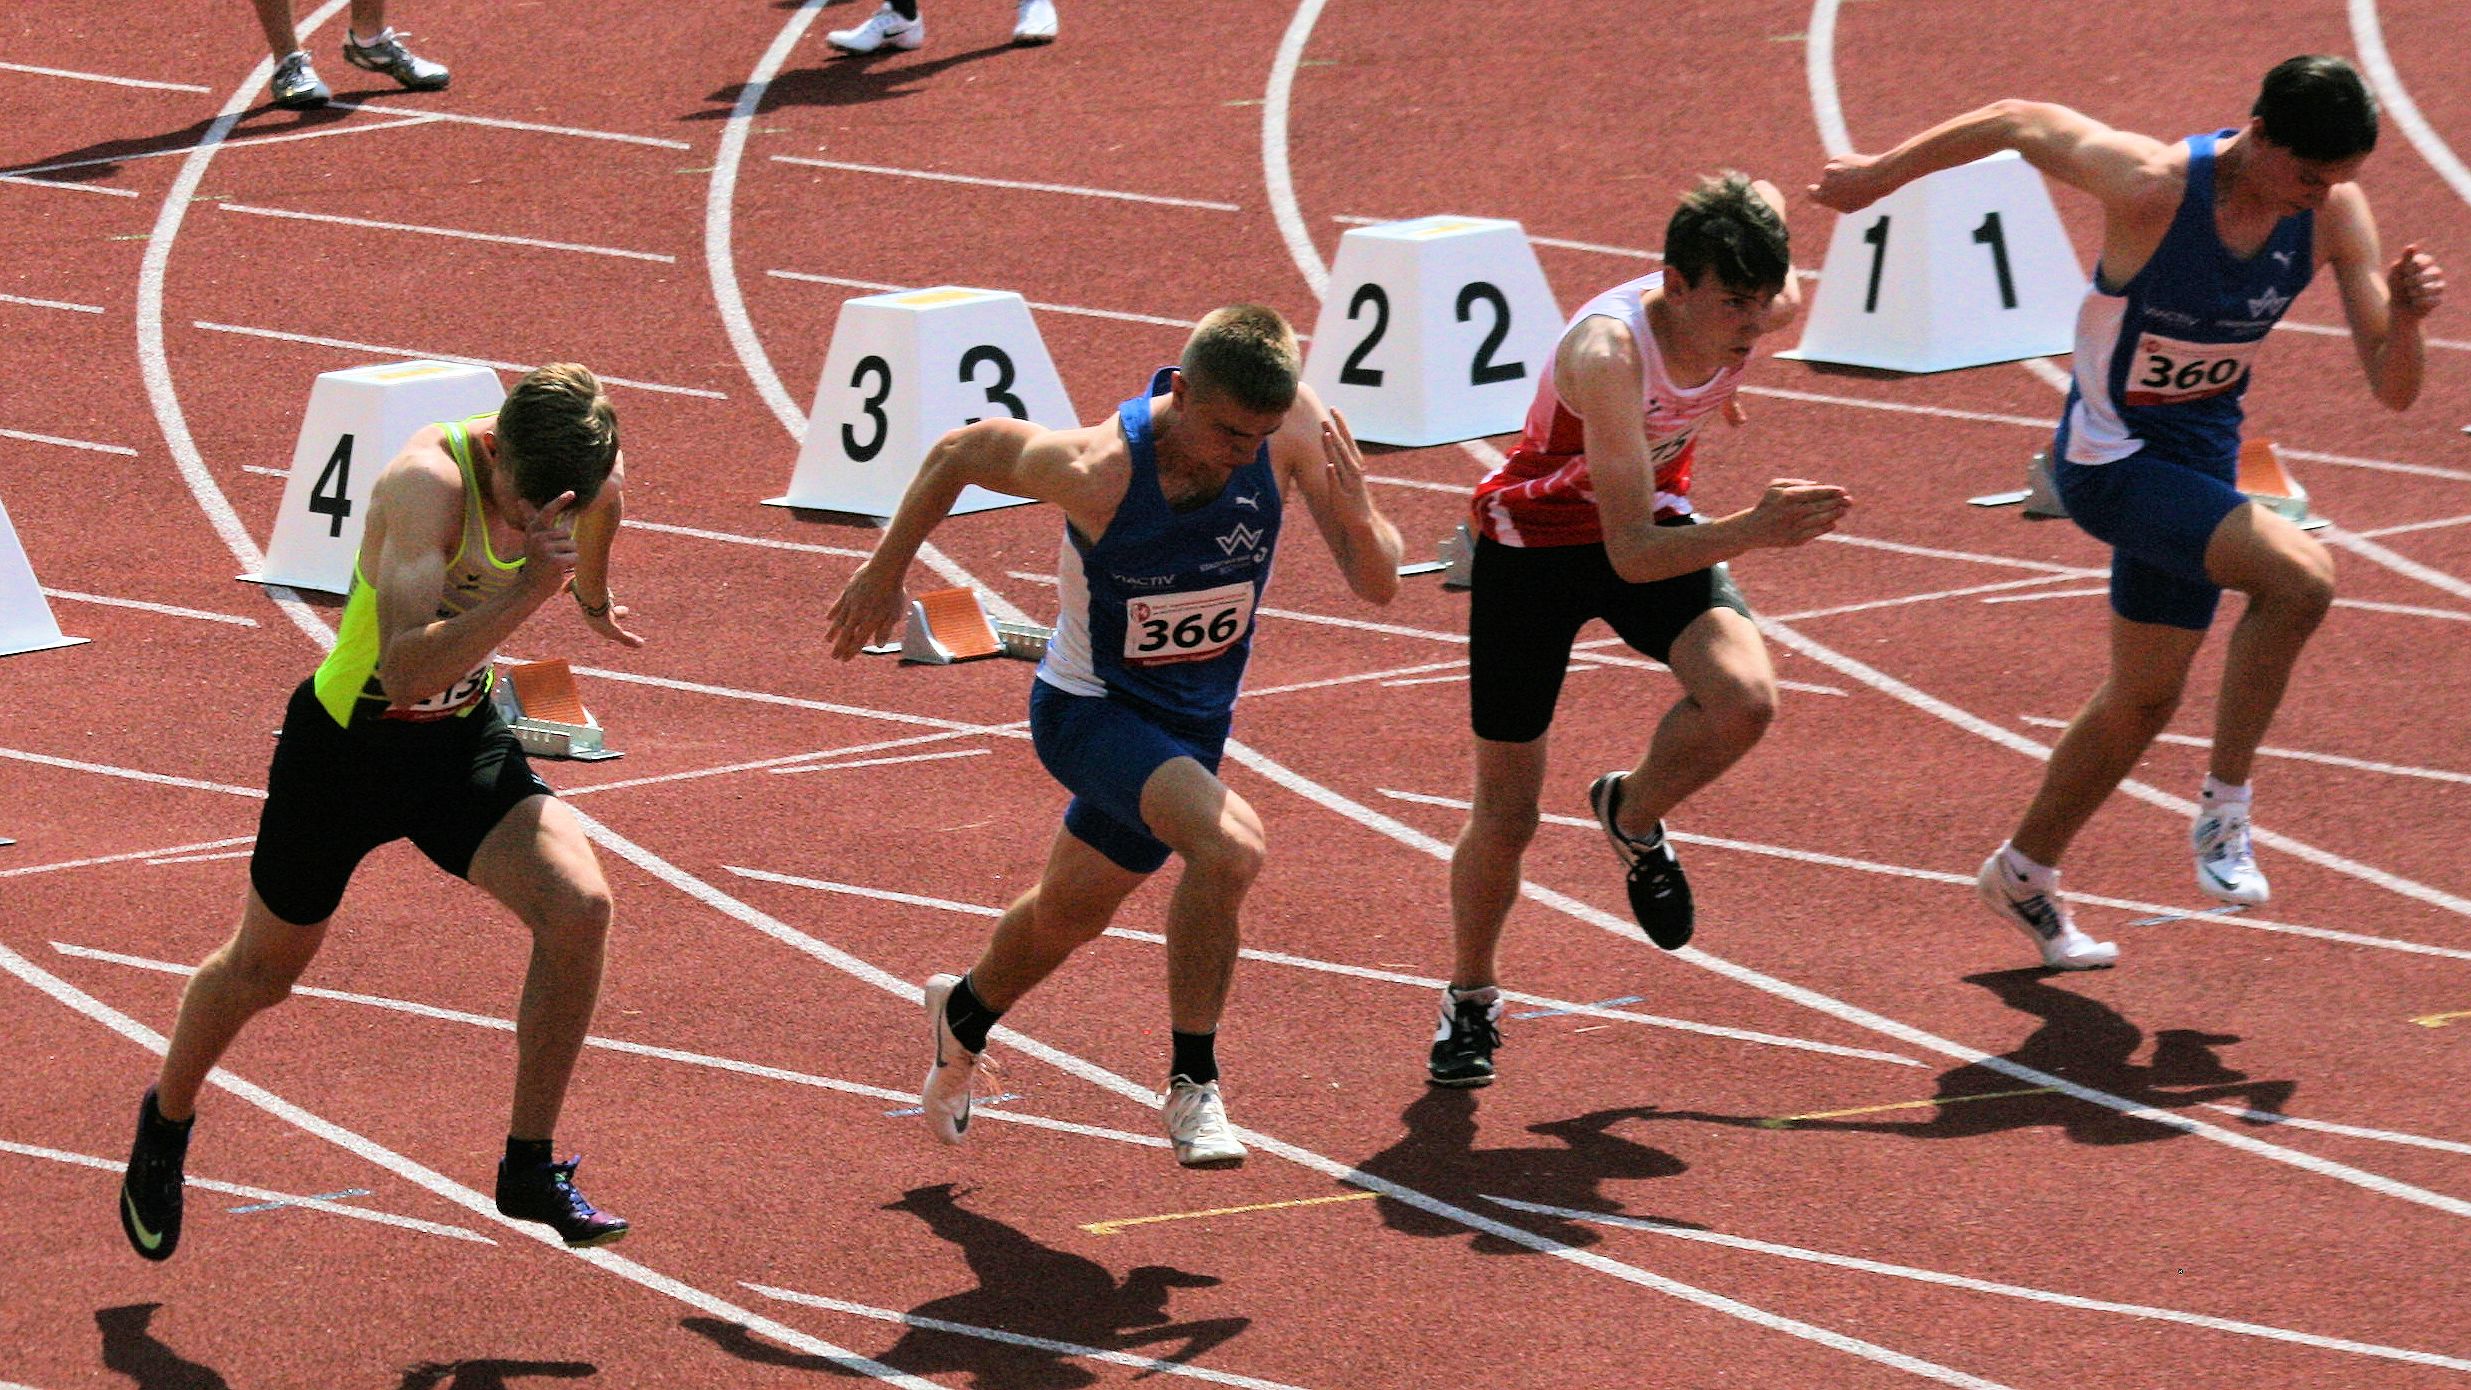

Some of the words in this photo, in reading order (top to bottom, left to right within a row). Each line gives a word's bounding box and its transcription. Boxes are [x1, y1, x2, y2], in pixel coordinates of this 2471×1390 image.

[1865, 215, 1890, 313] 1
[1972, 212, 2017, 309] 1
[1339, 282, 1390, 387] 2
[1455, 281, 1527, 386] 2
[2140, 355, 2240, 389] 360
[841, 355, 892, 463] 3
[308, 433, 354, 538] 4
[1137, 607, 1238, 652] 366
